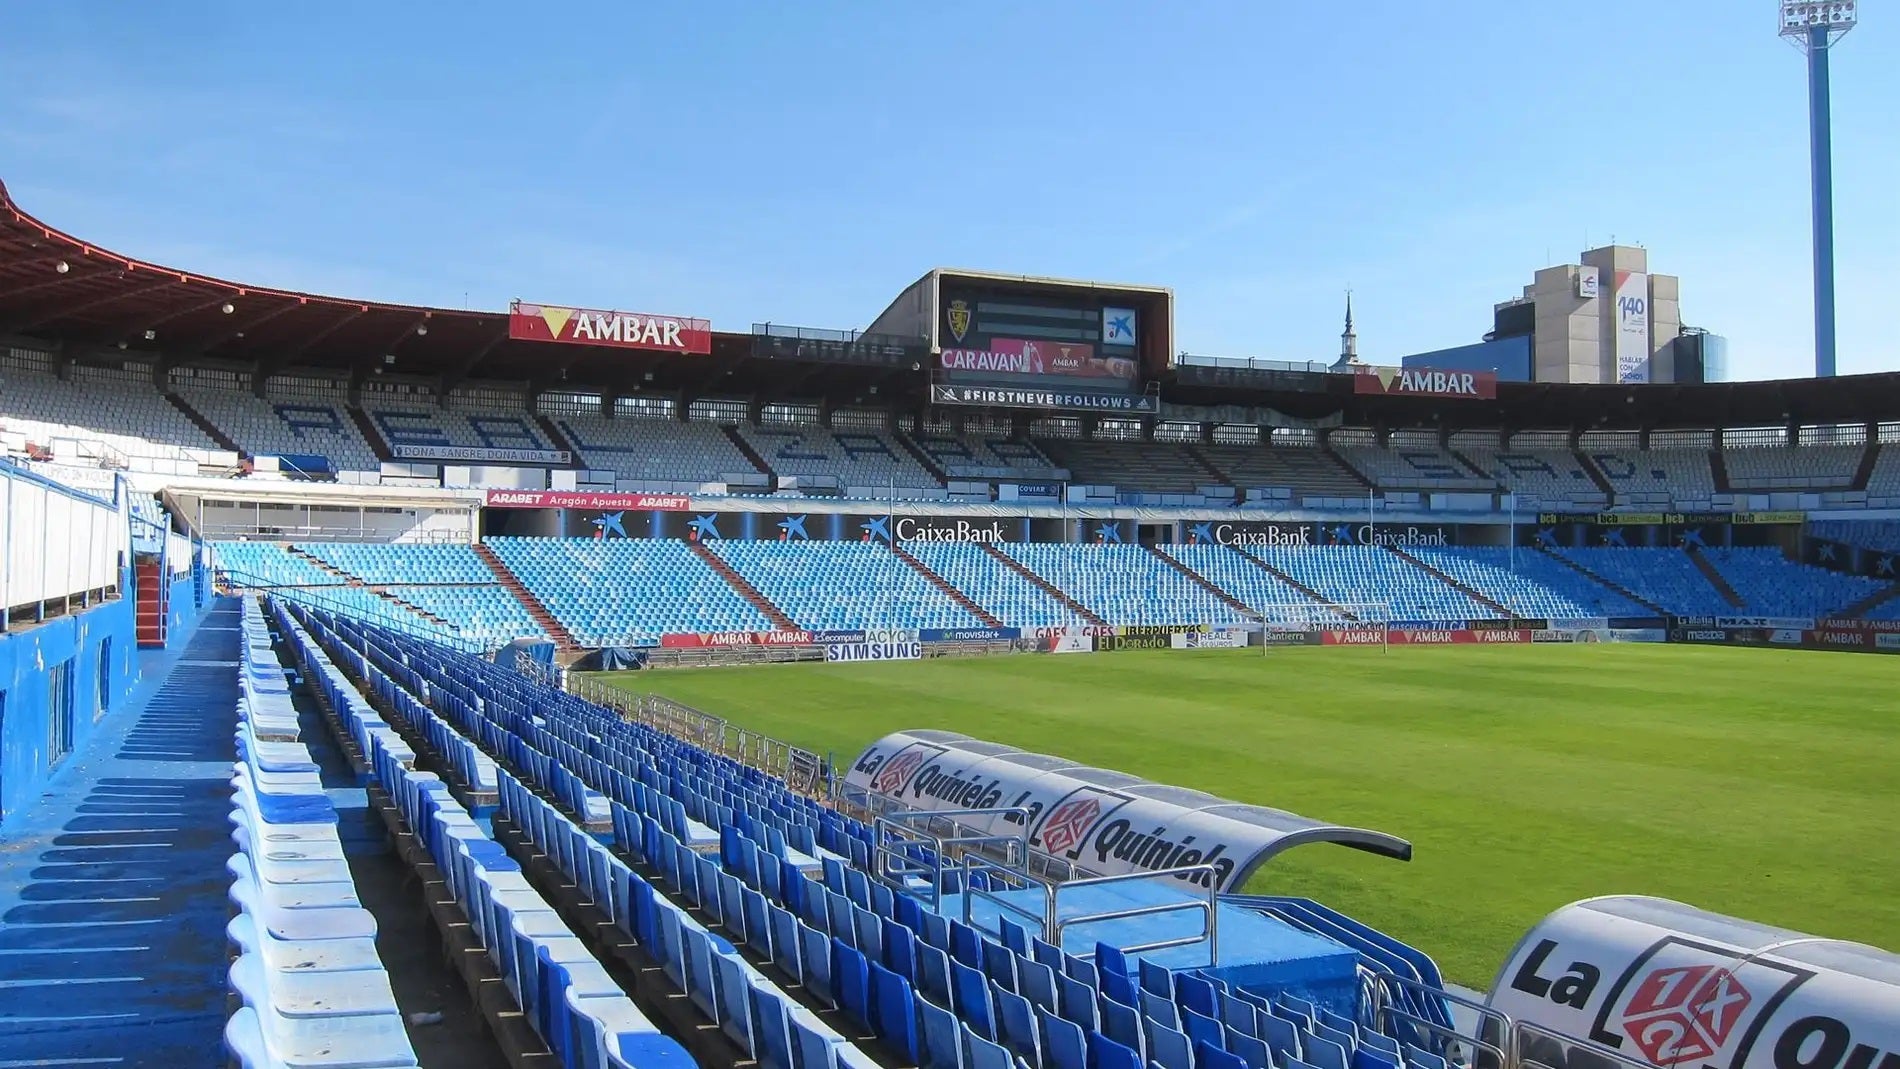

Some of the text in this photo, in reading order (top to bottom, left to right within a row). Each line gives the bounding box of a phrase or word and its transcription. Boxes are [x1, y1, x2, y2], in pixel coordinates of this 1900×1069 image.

[1617, 296, 1645, 322] 140
[572, 313, 685, 347] AMBAR
[1052, 357, 1079, 368] AMBAR
[1399, 370, 1477, 395] AMBAR
[963, 390, 1132, 409] #FIRSTNEVERFOLLOWS
[404, 447, 436, 457] DONA
[488, 451, 518, 460] DONA
[520, 452, 545, 461] VIDA
[489, 493, 687, 508] ARABET Aragón Apuesta ARABET
[896, 518, 1006, 543] CaixaBank
[1215, 524, 1310, 545] CaixaBank
[1357, 525, 1447, 546] CaixaBank
[1826, 619, 1857, 628] AMBAR
[710, 631, 809, 645] AMBAR AMBAR
[824, 632, 864, 644] ecomputer
[866, 630, 907, 643] ACYC
[1036, 626, 1066, 638] GAES
[1082, 625, 1114, 638] GAES
[1201, 632, 1233, 640] REALE
[1344, 631, 1382, 643] AMBAR
[1414, 631, 1452, 642] AMBAR
[1484, 631, 1520, 642] AMBAR
[1687, 630, 1726, 641] mazda
[1824, 631, 1864, 645] AMBAR
[828, 642, 921, 660] SAMSUNG
[855, 747, 884, 776] La
[914, 764, 1002, 809] Quiniela
[1004, 791, 1235, 888] La Quiniela
[1511, 938, 1601, 1010] La
